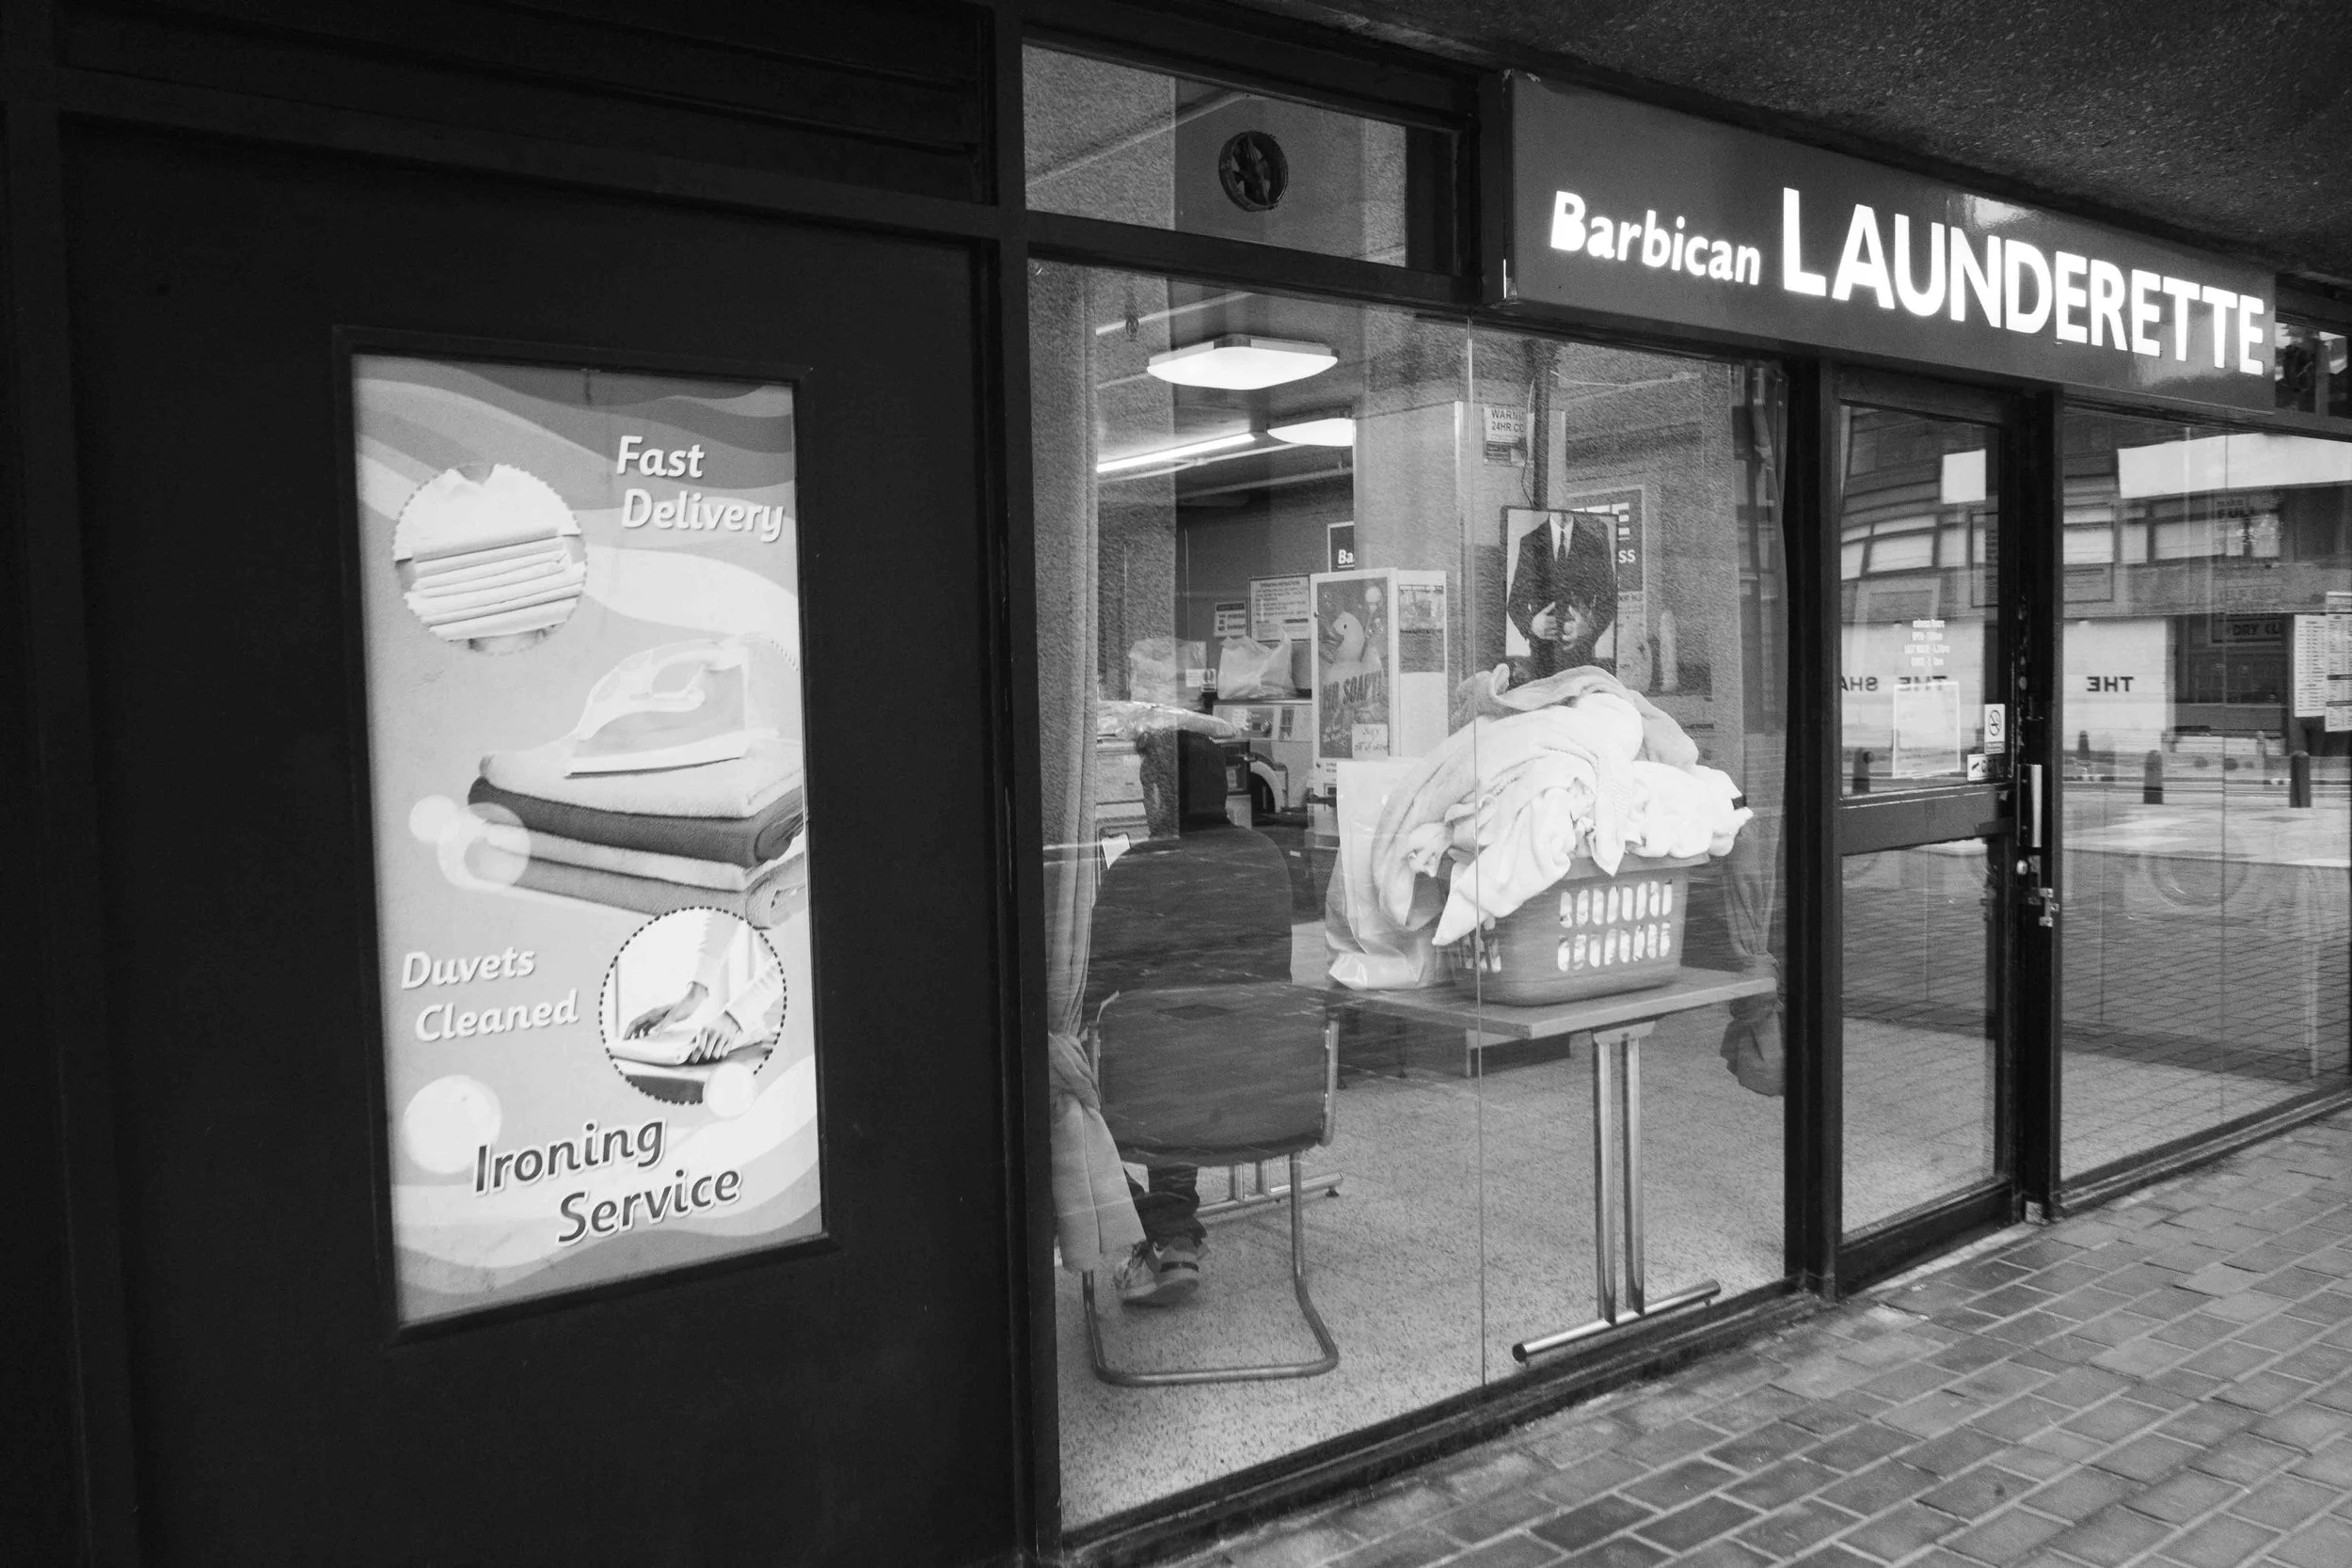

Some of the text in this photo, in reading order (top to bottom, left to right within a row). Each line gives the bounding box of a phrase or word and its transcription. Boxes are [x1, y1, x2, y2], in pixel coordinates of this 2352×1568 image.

[1550, 187, 2265, 375] Barbican LAUNDERETTE
[616, 436, 705, 478] Fast
[621, 487, 784, 543] Delivery
[401, 946, 537, 990] Duvets
[414, 989, 580, 1042] Cleaned
[474, 1119, 666, 1194] Ironing
[557, 1168, 741, 1243] Service
